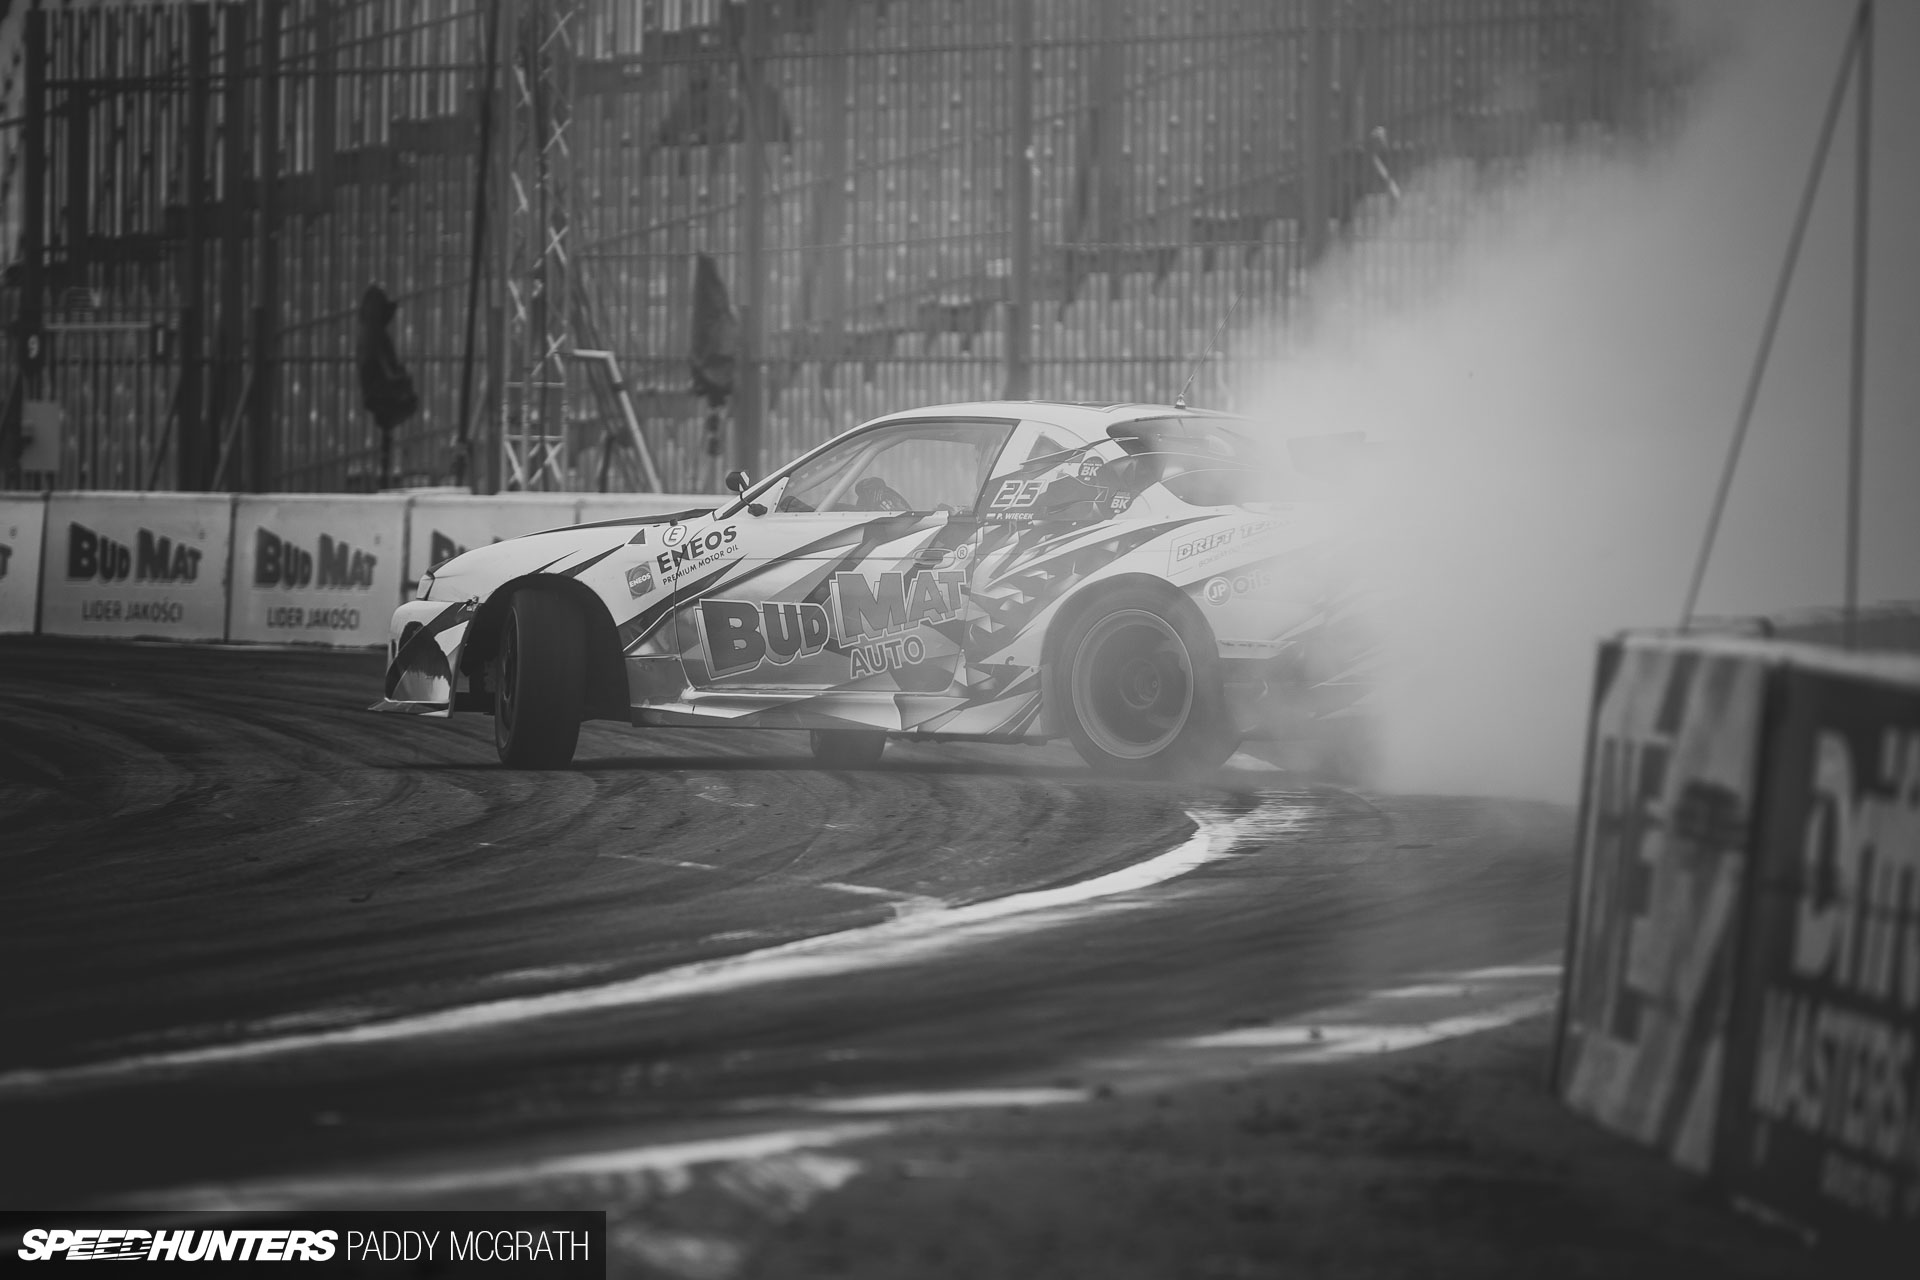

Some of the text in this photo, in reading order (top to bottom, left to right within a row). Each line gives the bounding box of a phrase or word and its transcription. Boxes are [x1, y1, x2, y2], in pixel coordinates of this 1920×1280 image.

[1081, 466, 1100, 476] BK
[990, 480, 1045, 508] 25
[1111, 498, 1129, 509] BK
[67, 521, 130, 582] BUD
[136, 527, 203, 583] MAT
[254, 525, 313, 589] BUD
[317, 532, 378, 590] MAT
[656, 525, 737, 574] ENEOS
[1176, 528, 1236, 562] DRIFT
[629, 572, 651, 588] ENEOS
[662, 544, 739, 585] PREMIUM MOTOR OIL
[82, 600, 121, 621] LIDER
[267, 607, 303, 629] LIDER
[694, 570, 966, 681] BUD MAT
[850, 635, 926, 680] AUTO
